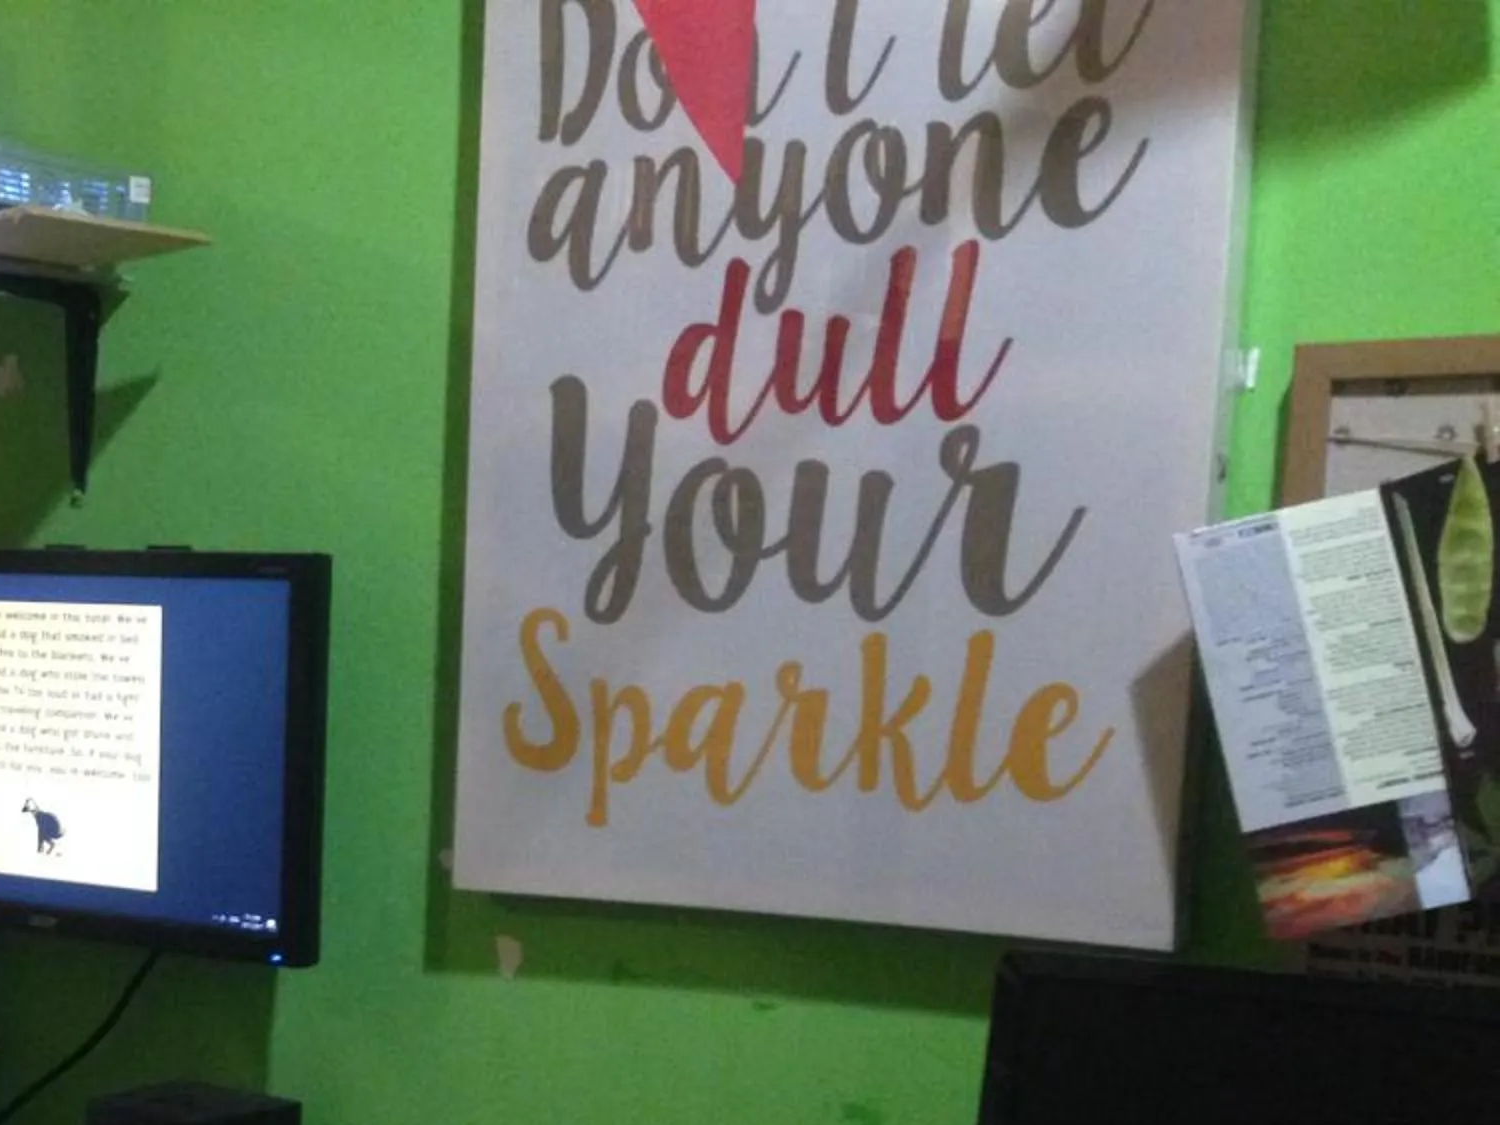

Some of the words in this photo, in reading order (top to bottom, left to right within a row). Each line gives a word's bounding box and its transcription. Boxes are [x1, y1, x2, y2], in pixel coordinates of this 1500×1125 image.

[538, 0, 895, 146] Dot
[527, 97, 1150, 314] anyone
[662, 239, 1014, 446] dull
[503, 607, 1115, 828] Sparkle
